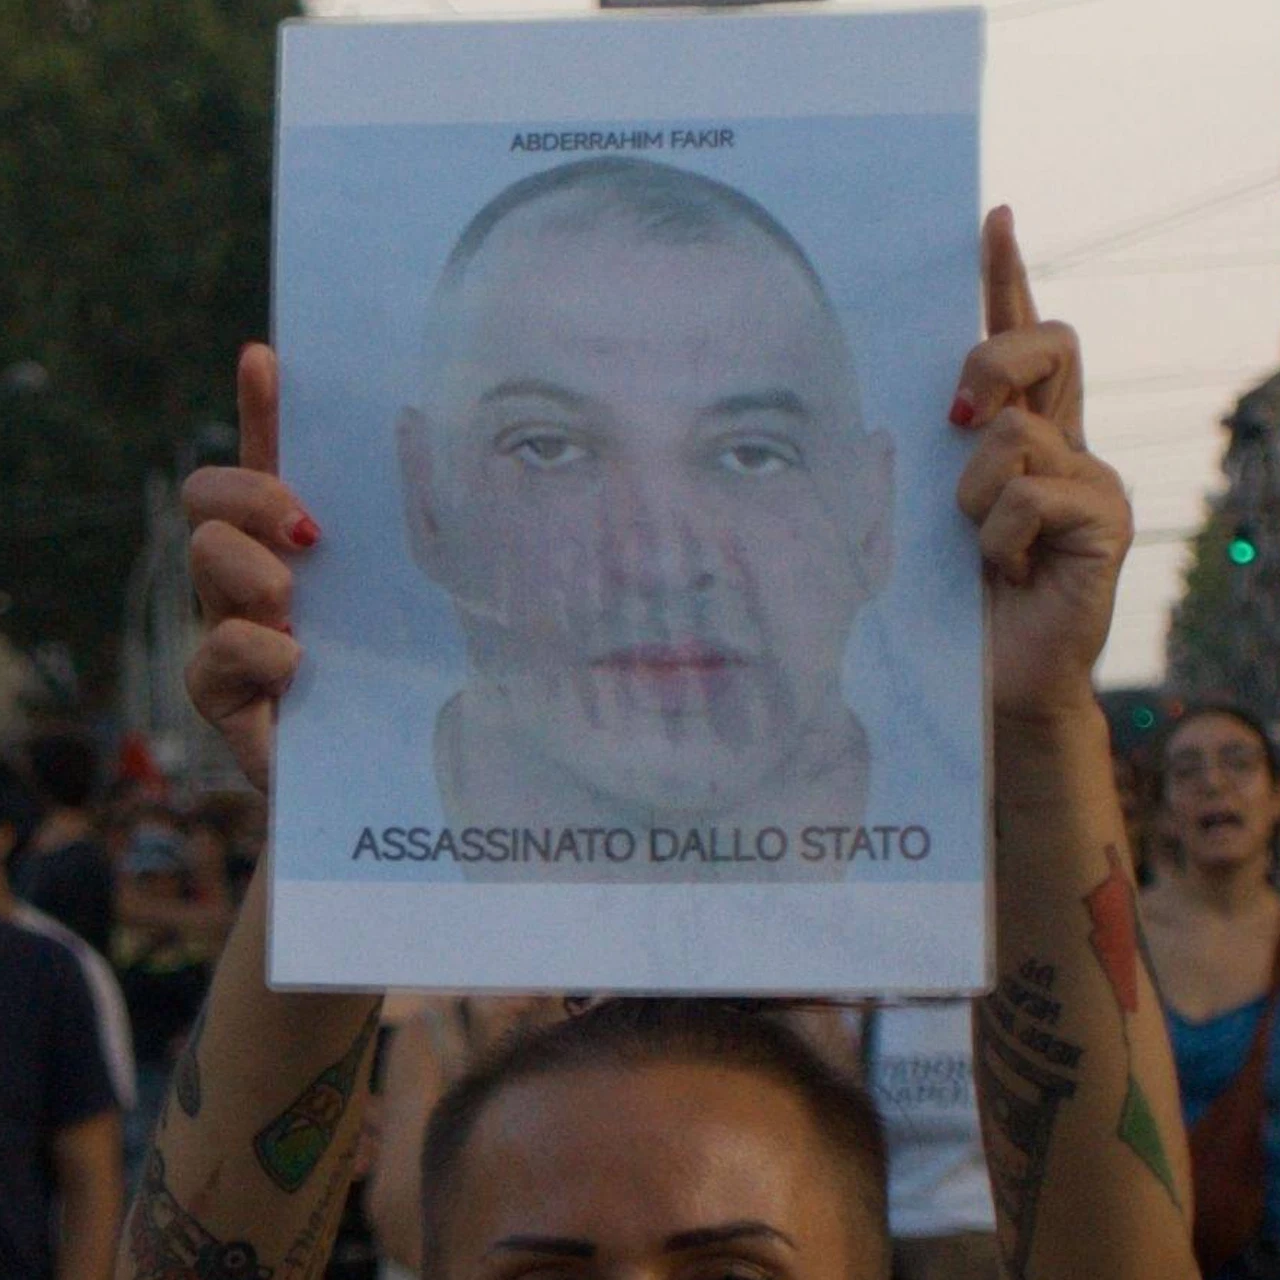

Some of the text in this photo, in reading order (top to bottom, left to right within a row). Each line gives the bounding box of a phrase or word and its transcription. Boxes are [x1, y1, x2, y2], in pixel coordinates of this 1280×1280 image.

[509, 128, 735, 152] ABDERRAHIM FAKIR
[351, 824, 932, 863] ASSASSINATO DALLO STATO
